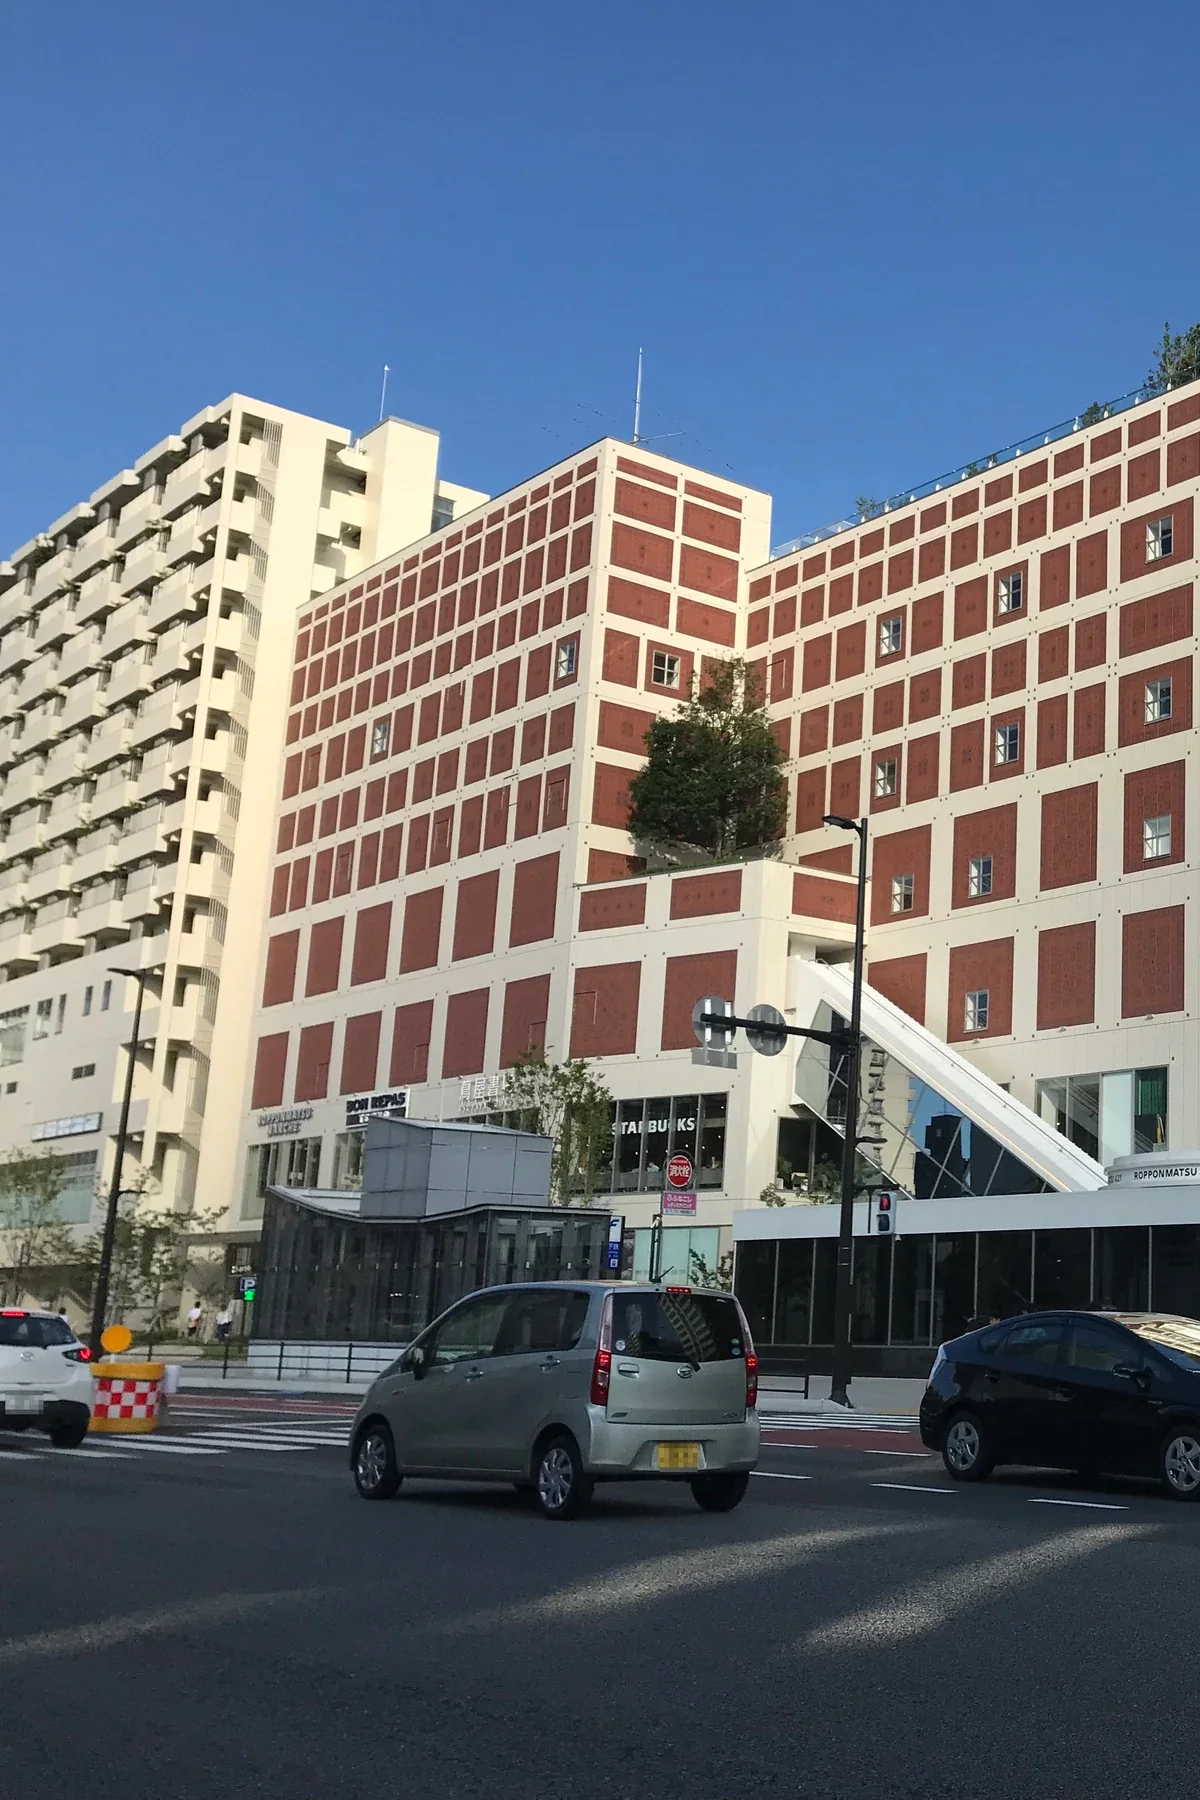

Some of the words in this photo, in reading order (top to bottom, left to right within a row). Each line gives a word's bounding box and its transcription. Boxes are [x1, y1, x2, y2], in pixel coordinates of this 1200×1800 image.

[346, 1097, 369, 1113] BON
[370, 1091, 406, 1109] REPAS
[612, 1117, 696, 1136] STABUKS
[669, 1165, 690, 1177] 消火栓
[1133, 1167, 1198, 1180] ROPPONMATSU
